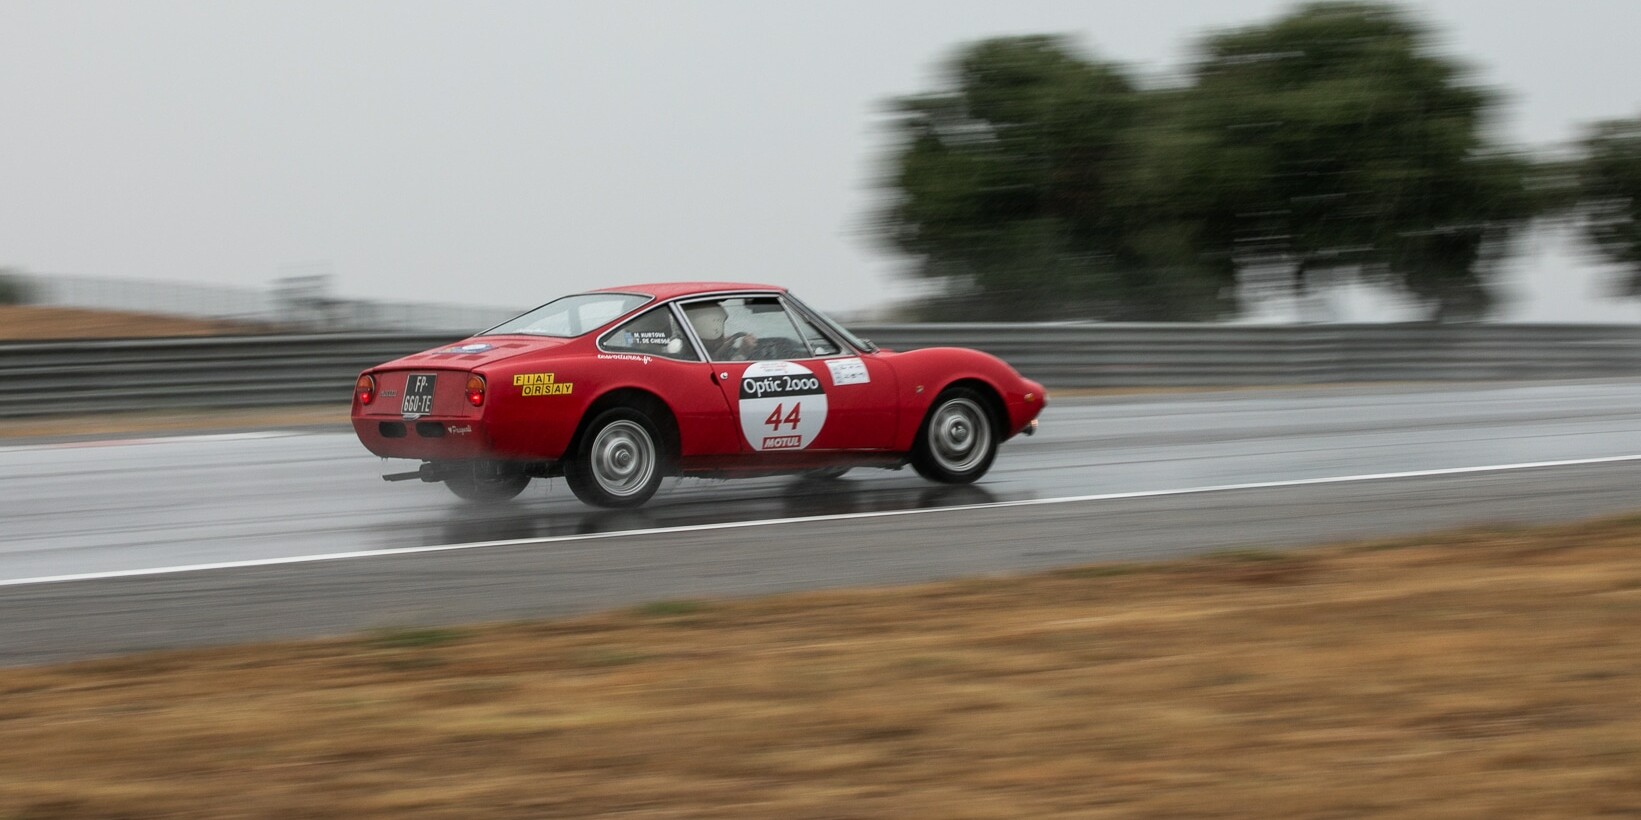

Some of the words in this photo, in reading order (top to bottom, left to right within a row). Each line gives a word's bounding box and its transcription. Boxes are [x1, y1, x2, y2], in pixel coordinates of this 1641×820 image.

[516, 374, 553, 384] FIAT
[523, 384, 571, 395] ORSAY
[743, 377, 782, 398] Optic
[783, 376, 819, 392] 2000
[764, 401, 801, 432] 44
[764, 436, 800, 449] MOTUL
